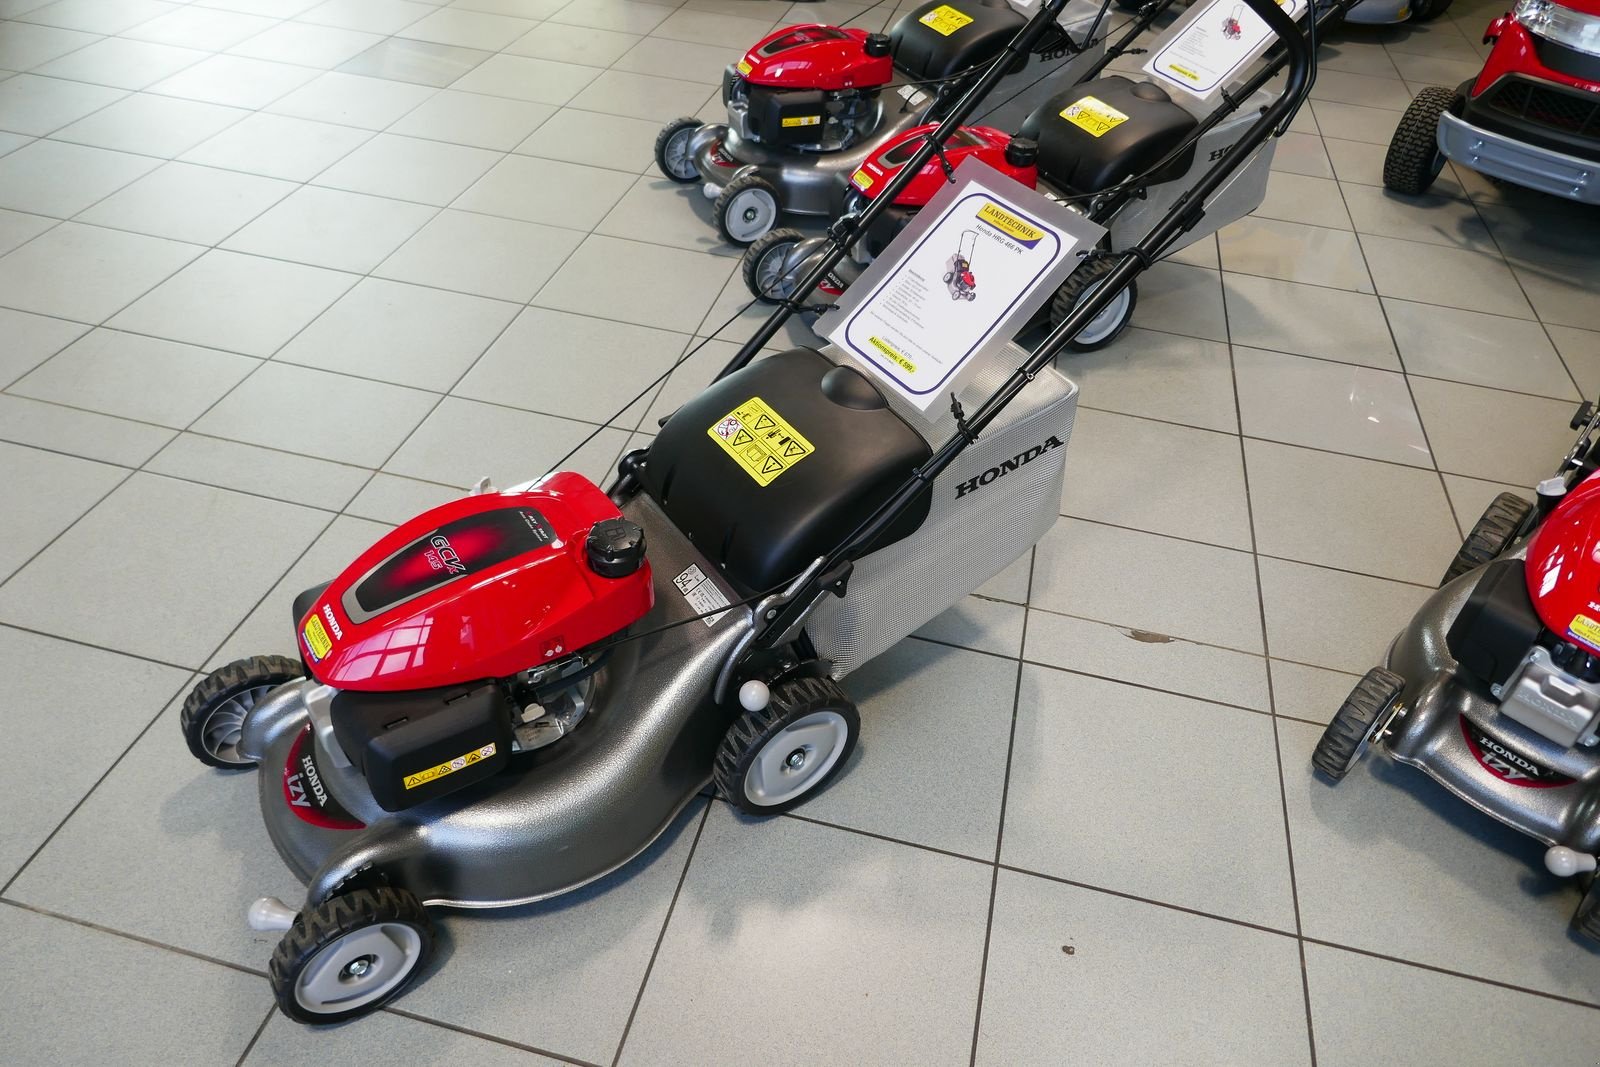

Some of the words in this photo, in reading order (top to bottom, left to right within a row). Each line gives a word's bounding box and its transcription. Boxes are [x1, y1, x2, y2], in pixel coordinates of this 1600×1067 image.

[984, 205, 1037, 238] LANDTECHNIK
[976, 224, 993, 238] Honda
[992, 233, 1006, 246] HRG
[1014, 246, 1024, 256] PK
[868, 336, 899, 363] Aktionspreis:
[955, 435, 1064, 500] HONDA
[322, 603, 343, 641] HONDA
[1480, 736, 1540, 777] HONDA
[287, 772, 312, 807] izy
[302, 754, 329, 807] HONDA
